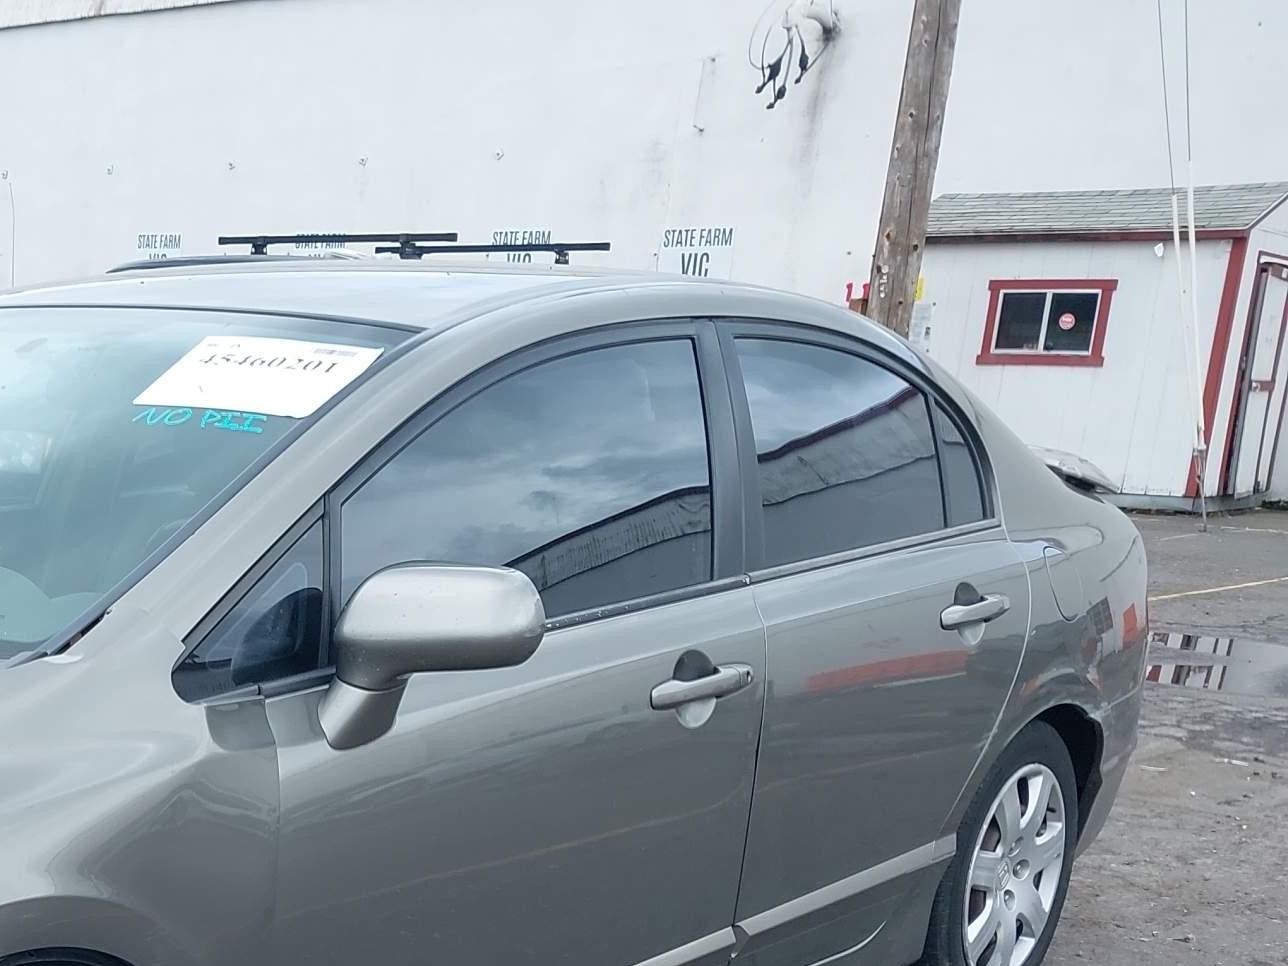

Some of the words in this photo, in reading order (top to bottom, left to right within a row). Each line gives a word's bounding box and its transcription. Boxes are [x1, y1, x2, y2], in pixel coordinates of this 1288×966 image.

[137, 234, 159, 249] STATE
[159, 234, 182, 249] FARM
[492, 231, 520, 245] STATE
[522, 230, 552, 245] FARM
[663, 228, 697, 248] STATE
[698, 227, 734, 247] FARM
[132, 406, 193, 426] NO
